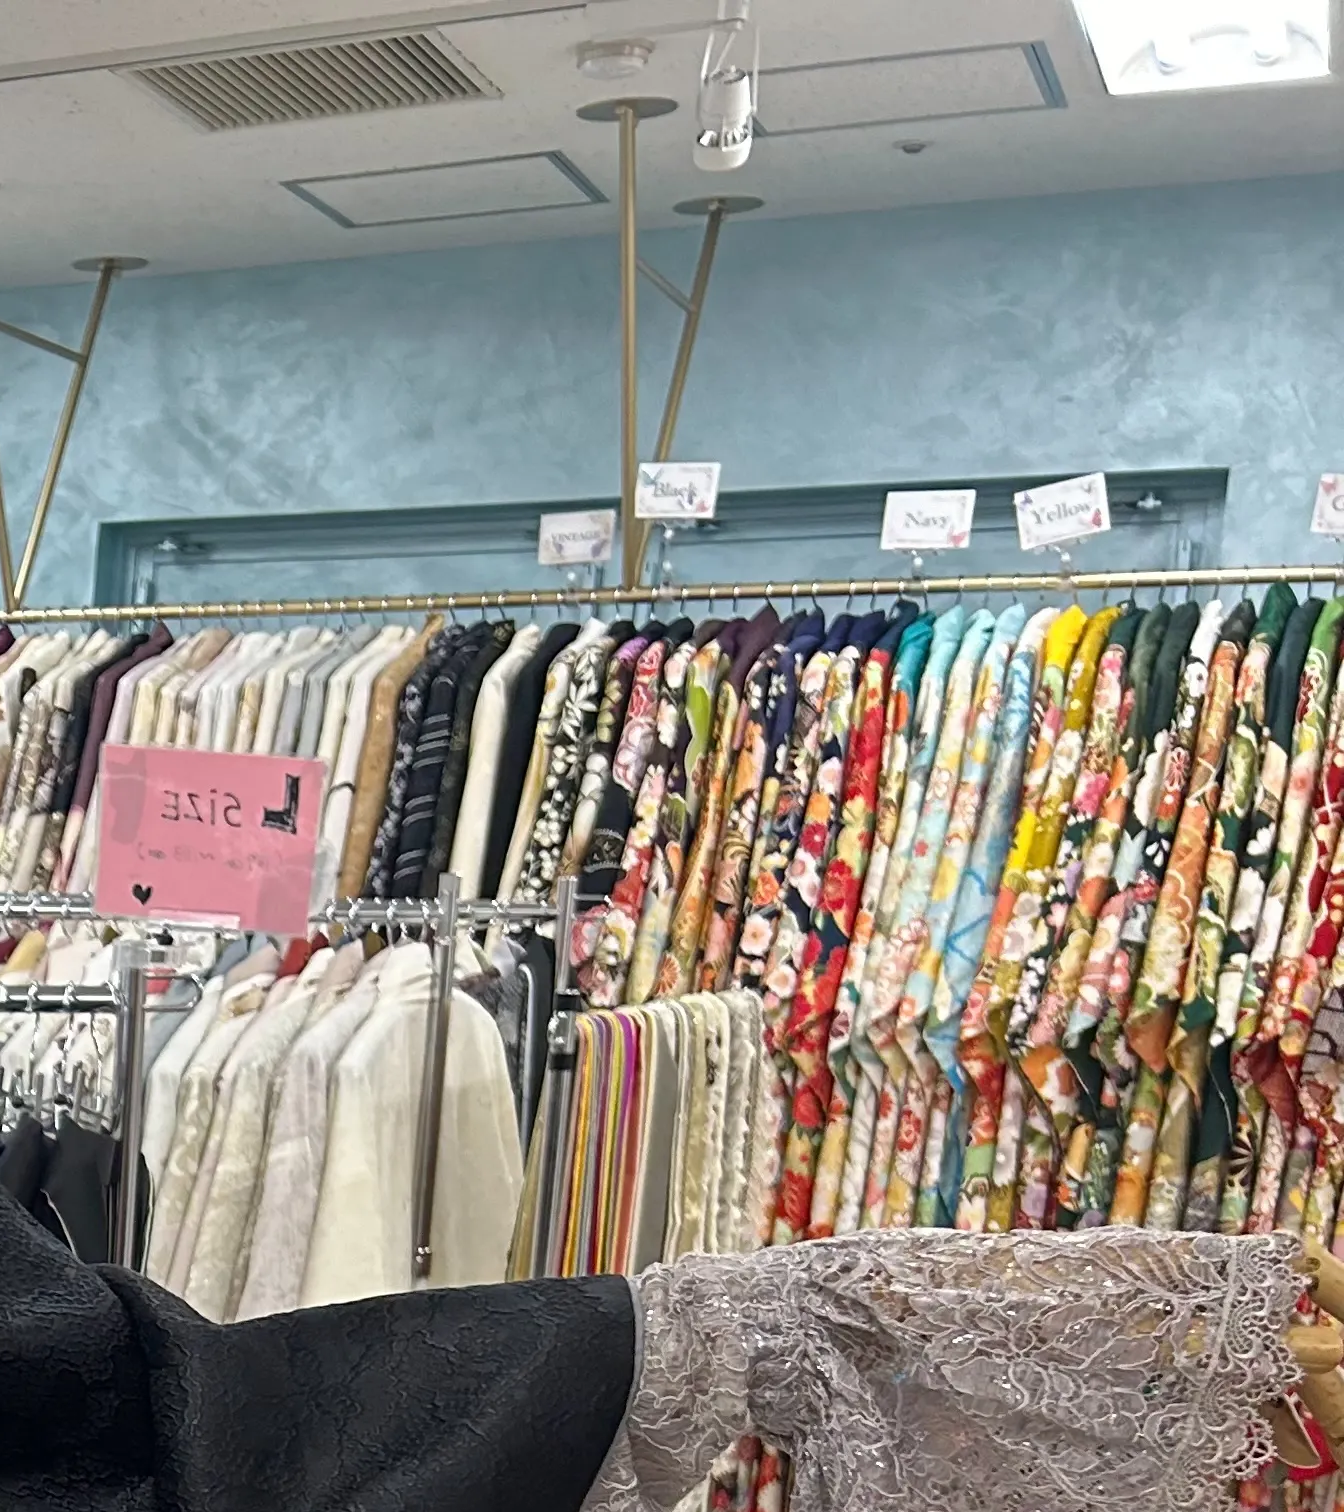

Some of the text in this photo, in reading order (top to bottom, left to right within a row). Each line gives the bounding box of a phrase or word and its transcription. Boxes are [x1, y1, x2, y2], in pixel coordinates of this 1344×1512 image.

[652, 480, 697, 498] Black
[904, 510, 951, 529] Navy
[1030, 502, 1093, 526] Yellow
